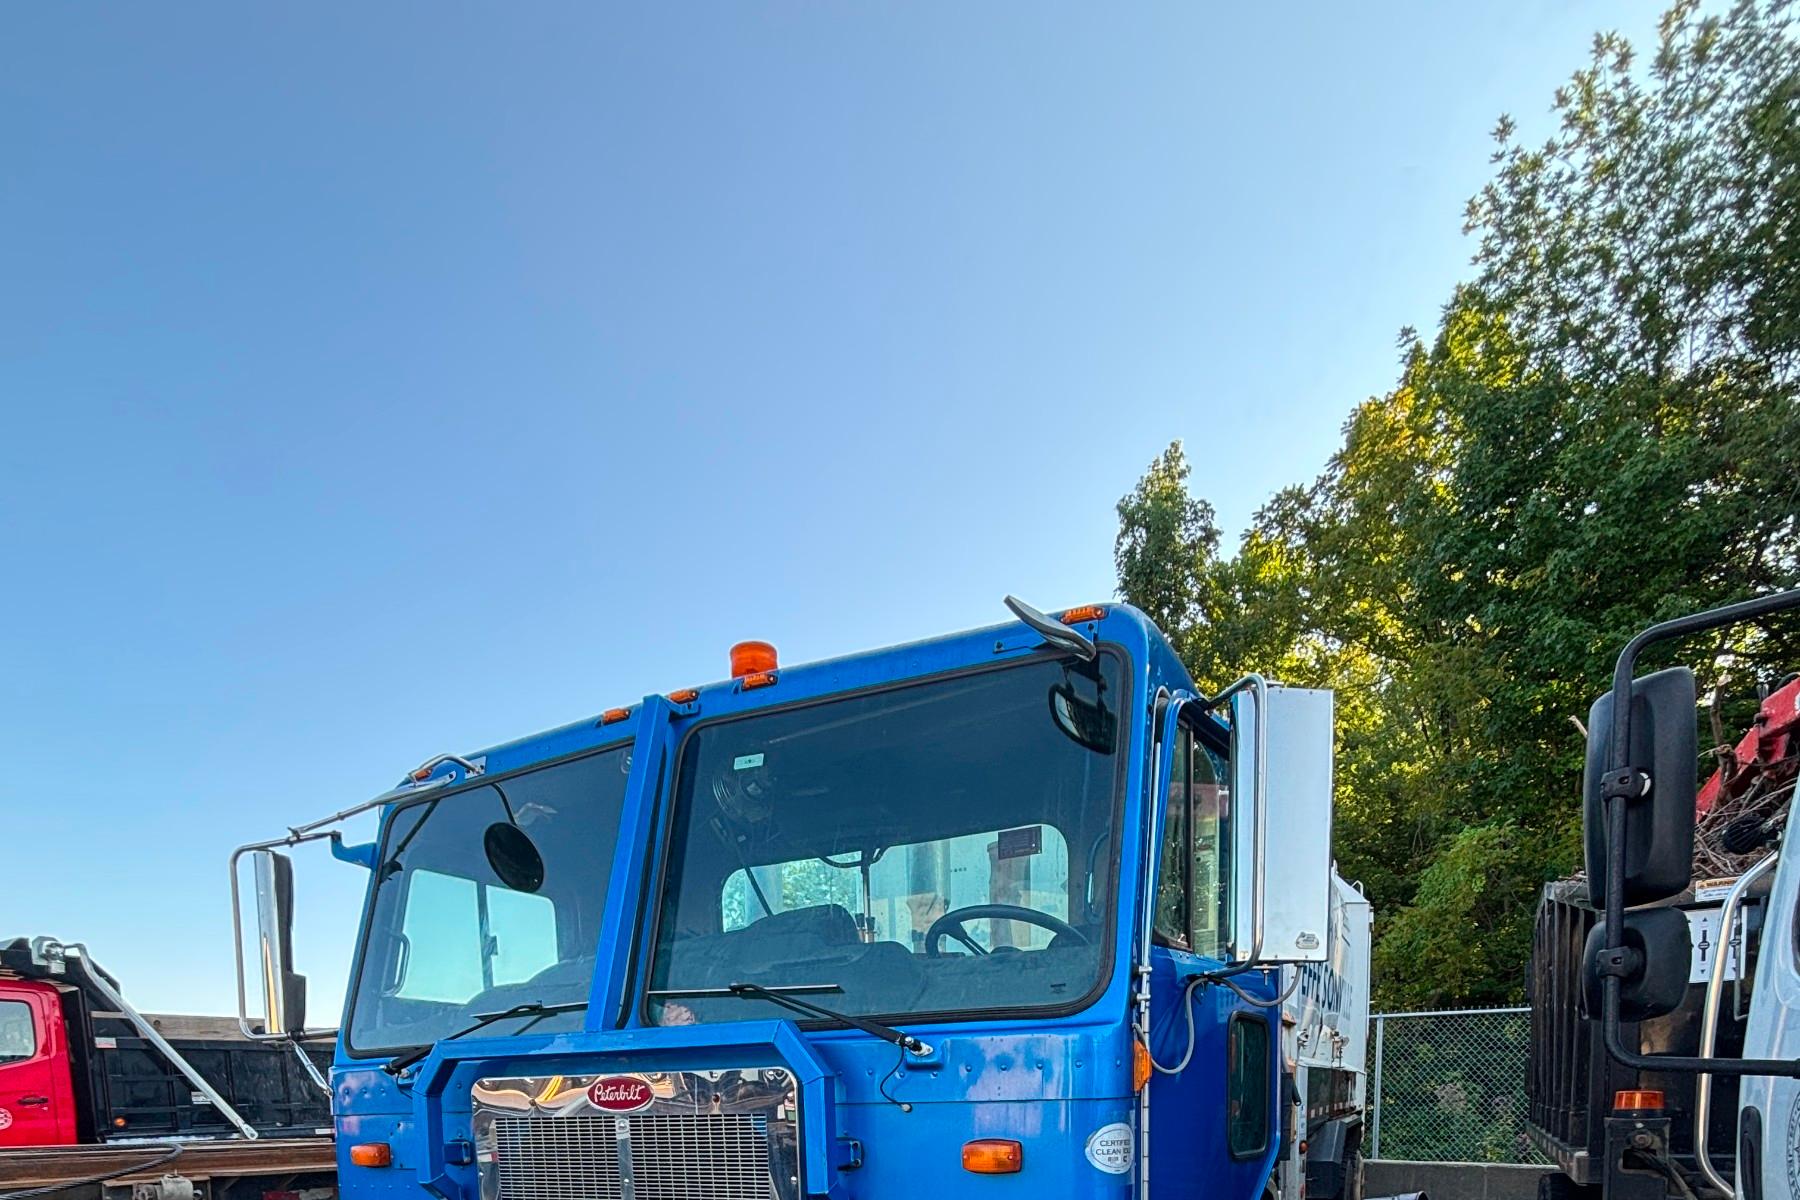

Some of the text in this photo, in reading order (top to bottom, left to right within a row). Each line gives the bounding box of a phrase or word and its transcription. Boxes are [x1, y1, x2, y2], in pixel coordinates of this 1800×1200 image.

[594, 1083, 646, 1103] Peterbilt
[1099, 1139, 1131, 1147] CERTIFIE
[1095, 1147, 1122, 1155] CLEAN
